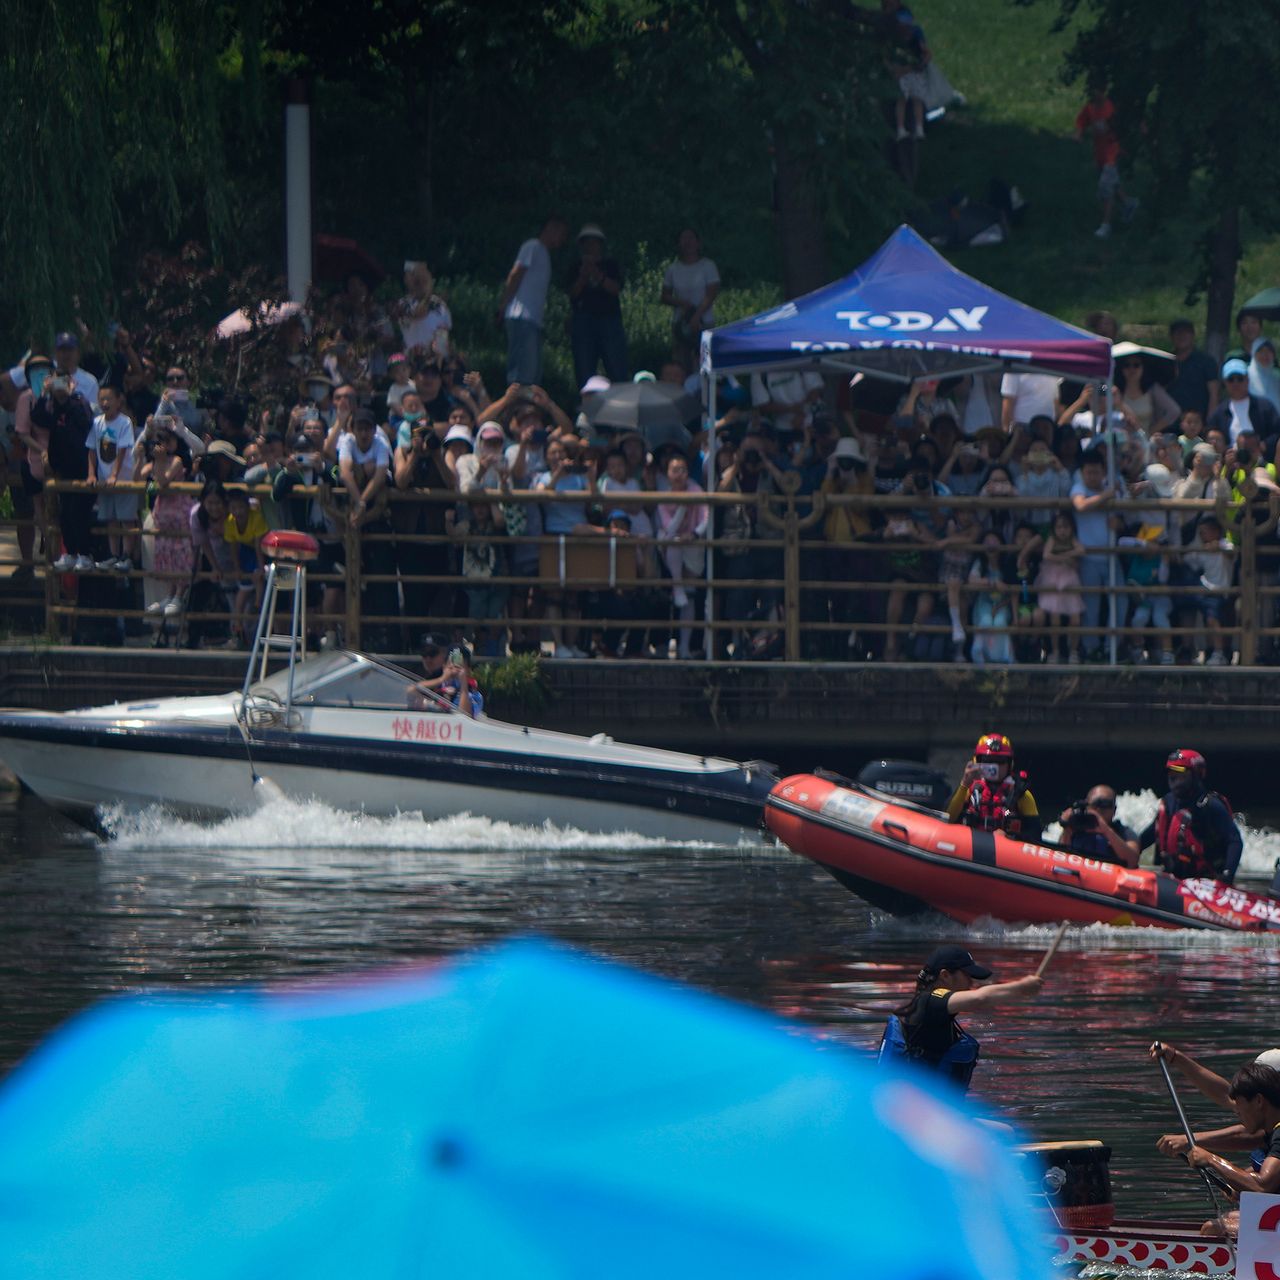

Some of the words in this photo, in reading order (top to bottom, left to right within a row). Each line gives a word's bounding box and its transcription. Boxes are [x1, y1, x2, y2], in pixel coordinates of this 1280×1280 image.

[836, 306, 988, 331] TODAY
[876, 780, 933, 796] SUZUKI
[1022, 843, 1114, 875] RESCUE
